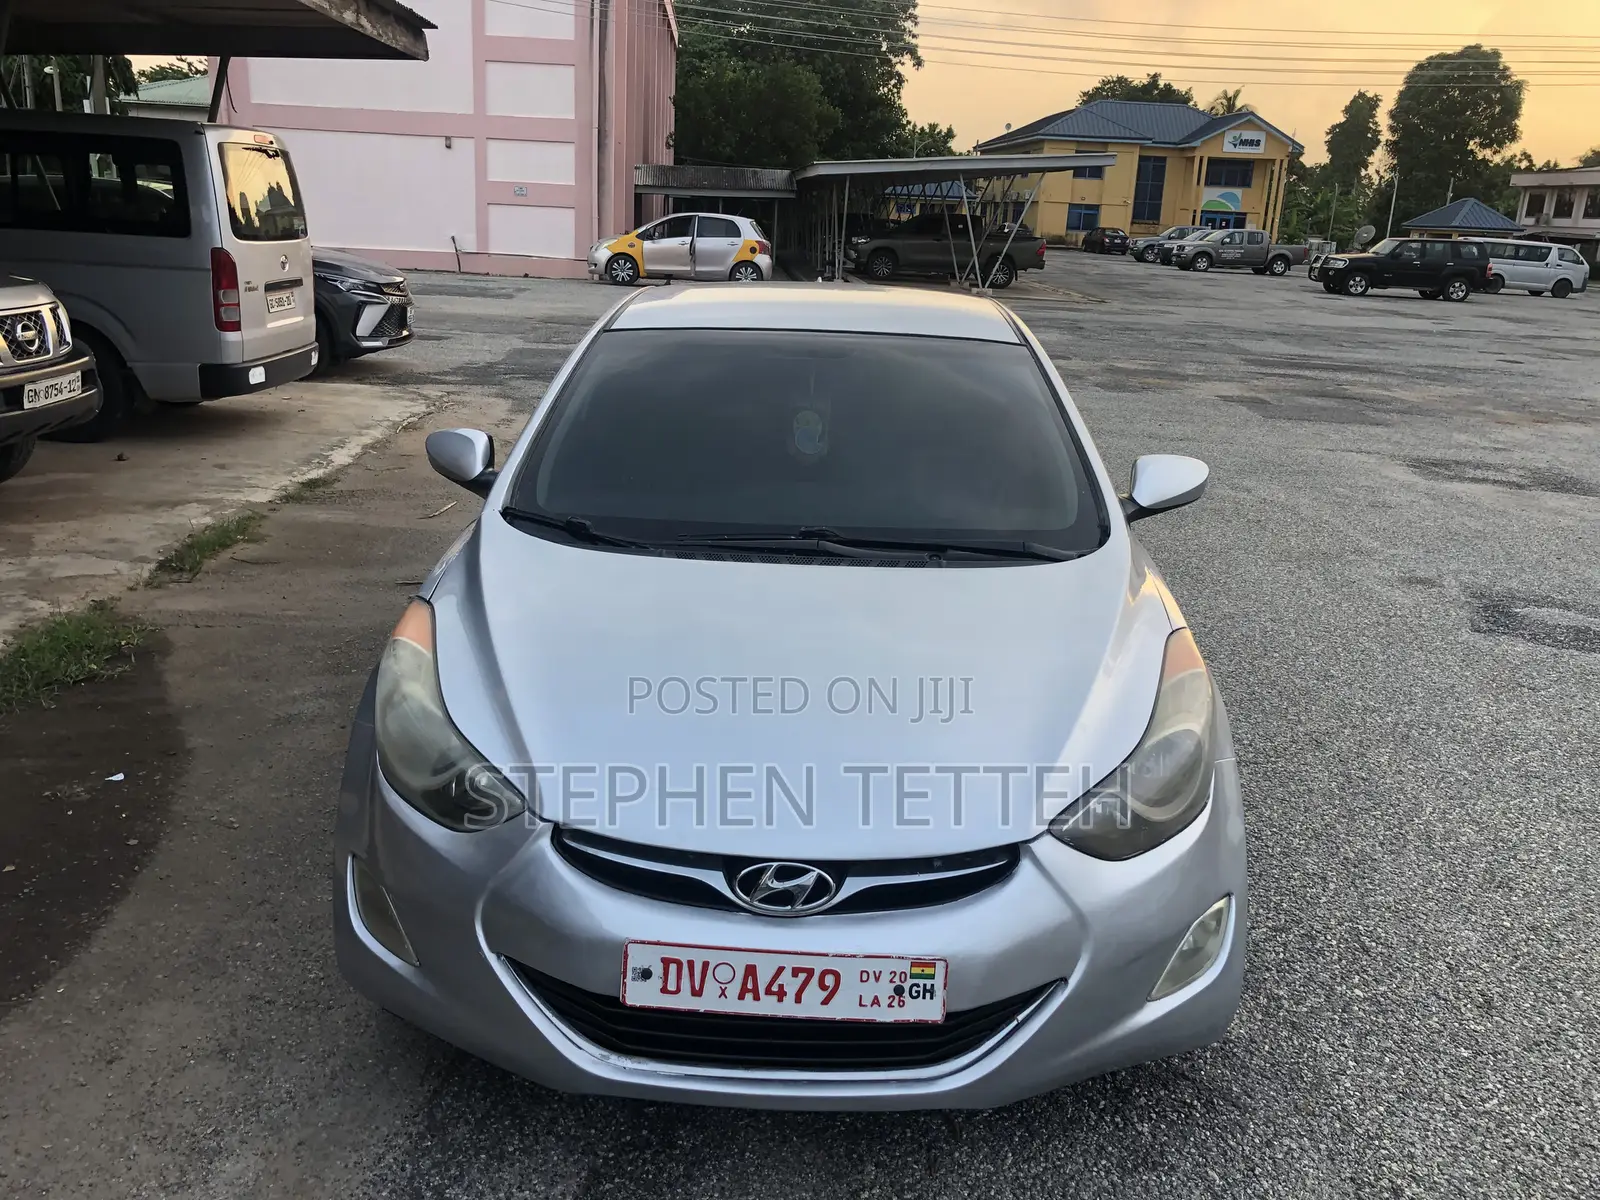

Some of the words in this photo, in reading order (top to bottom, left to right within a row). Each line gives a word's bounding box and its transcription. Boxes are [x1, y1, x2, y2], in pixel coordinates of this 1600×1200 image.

[1238, 138, 1262, 148] NHIS
[27, 388, 41, 404] GN
[44, 379, 77, 400] 8754-12
[659, 956, 711, 998] DV
[737, 963, 842, 1006] A479
[859, 969, 883, 983] DV
[888, 970, 908, 984] 20
[908, 983, 936, 1000] GH
[858, 994, 881, 1008] LA
[886, 994, 906, 1008] 26
